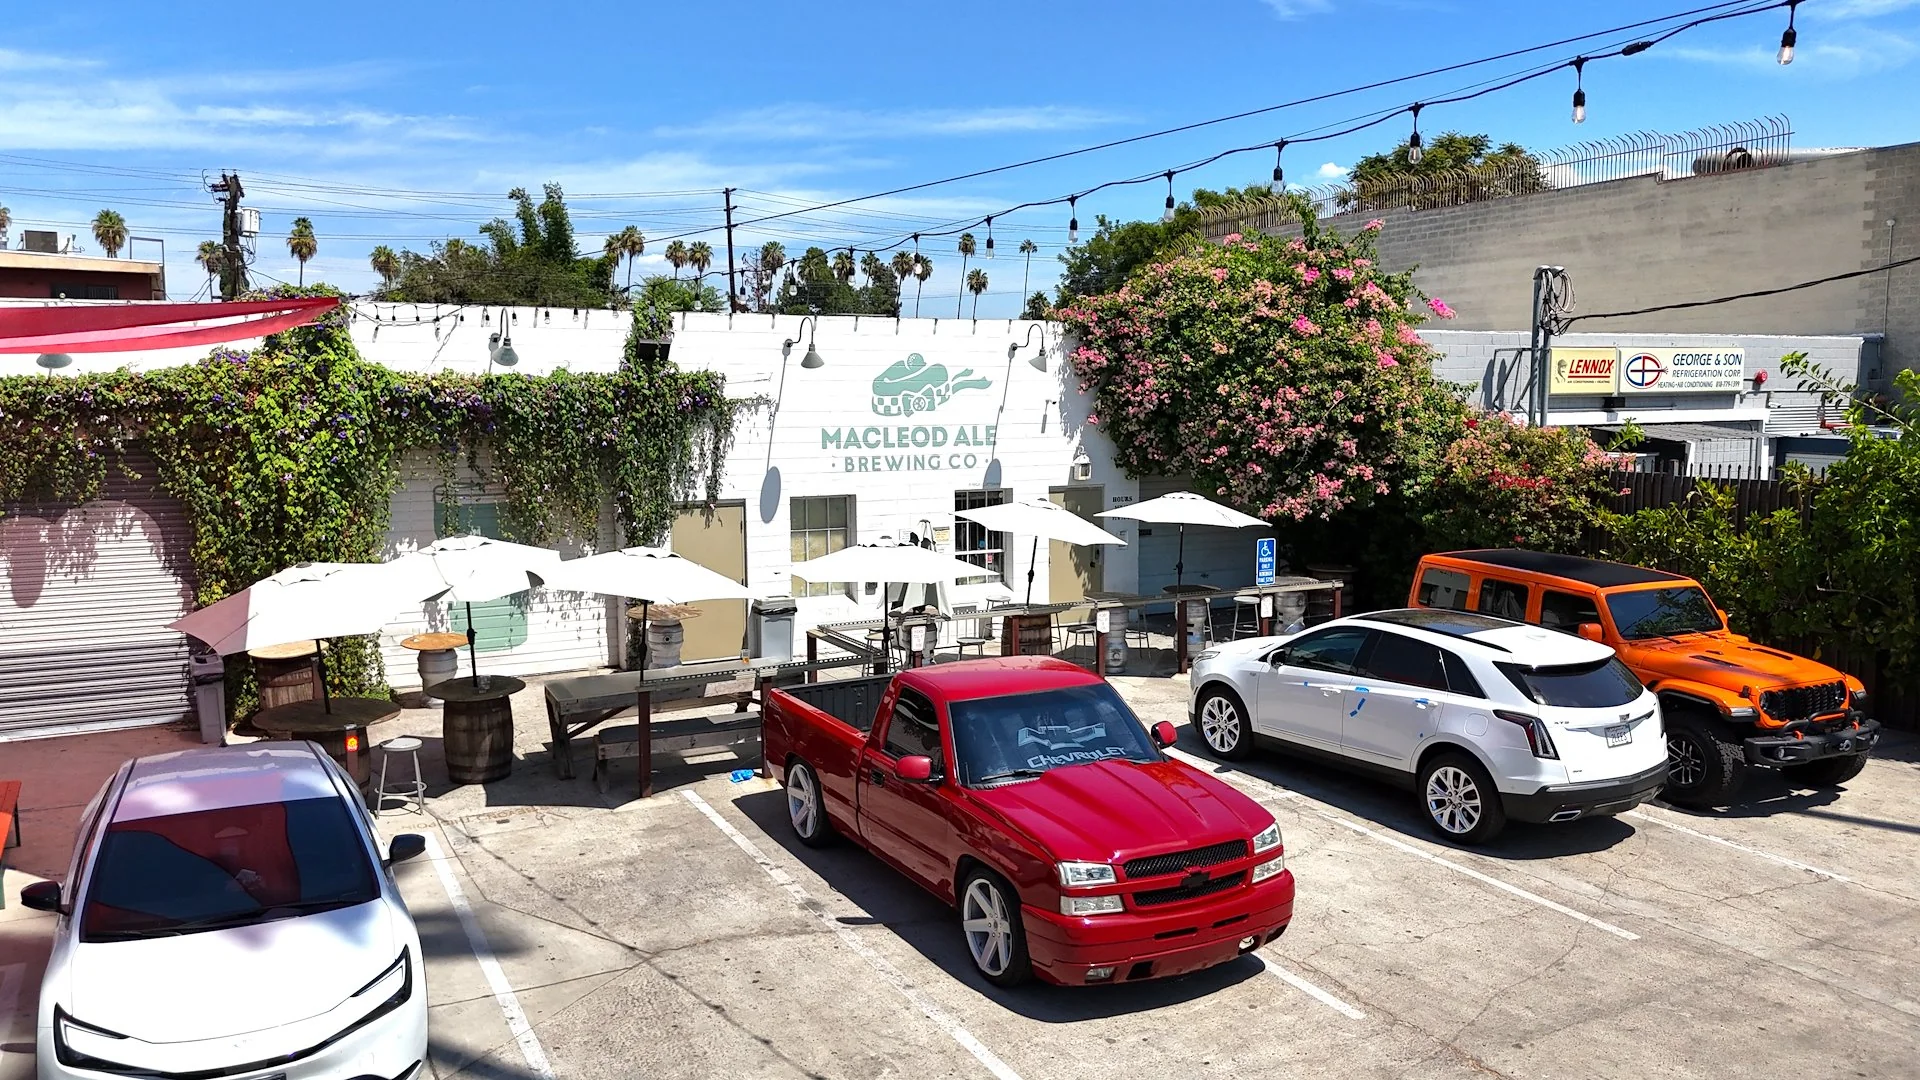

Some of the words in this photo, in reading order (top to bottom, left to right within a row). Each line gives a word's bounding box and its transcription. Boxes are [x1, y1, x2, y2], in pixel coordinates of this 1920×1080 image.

[1569, 359, 1615, 374] LENNOX
[1672, 353, 1712, 366] GEORGE
[1714, 353, 1721, 366] &
[1722, 353, 1742, 366] SON
[1672, 369, 1722, 378] REFRIGERATION
[1724, 369, 1741, 377] CORP.
[821, 426, 948, 450] MACLEOD
[953, 425, 998, 447] ALE
[844, 455, 941, 472] BREWING
[948, 453, 977, 470] CO
[1027, 746, 1126, 769] CHEVROLET
